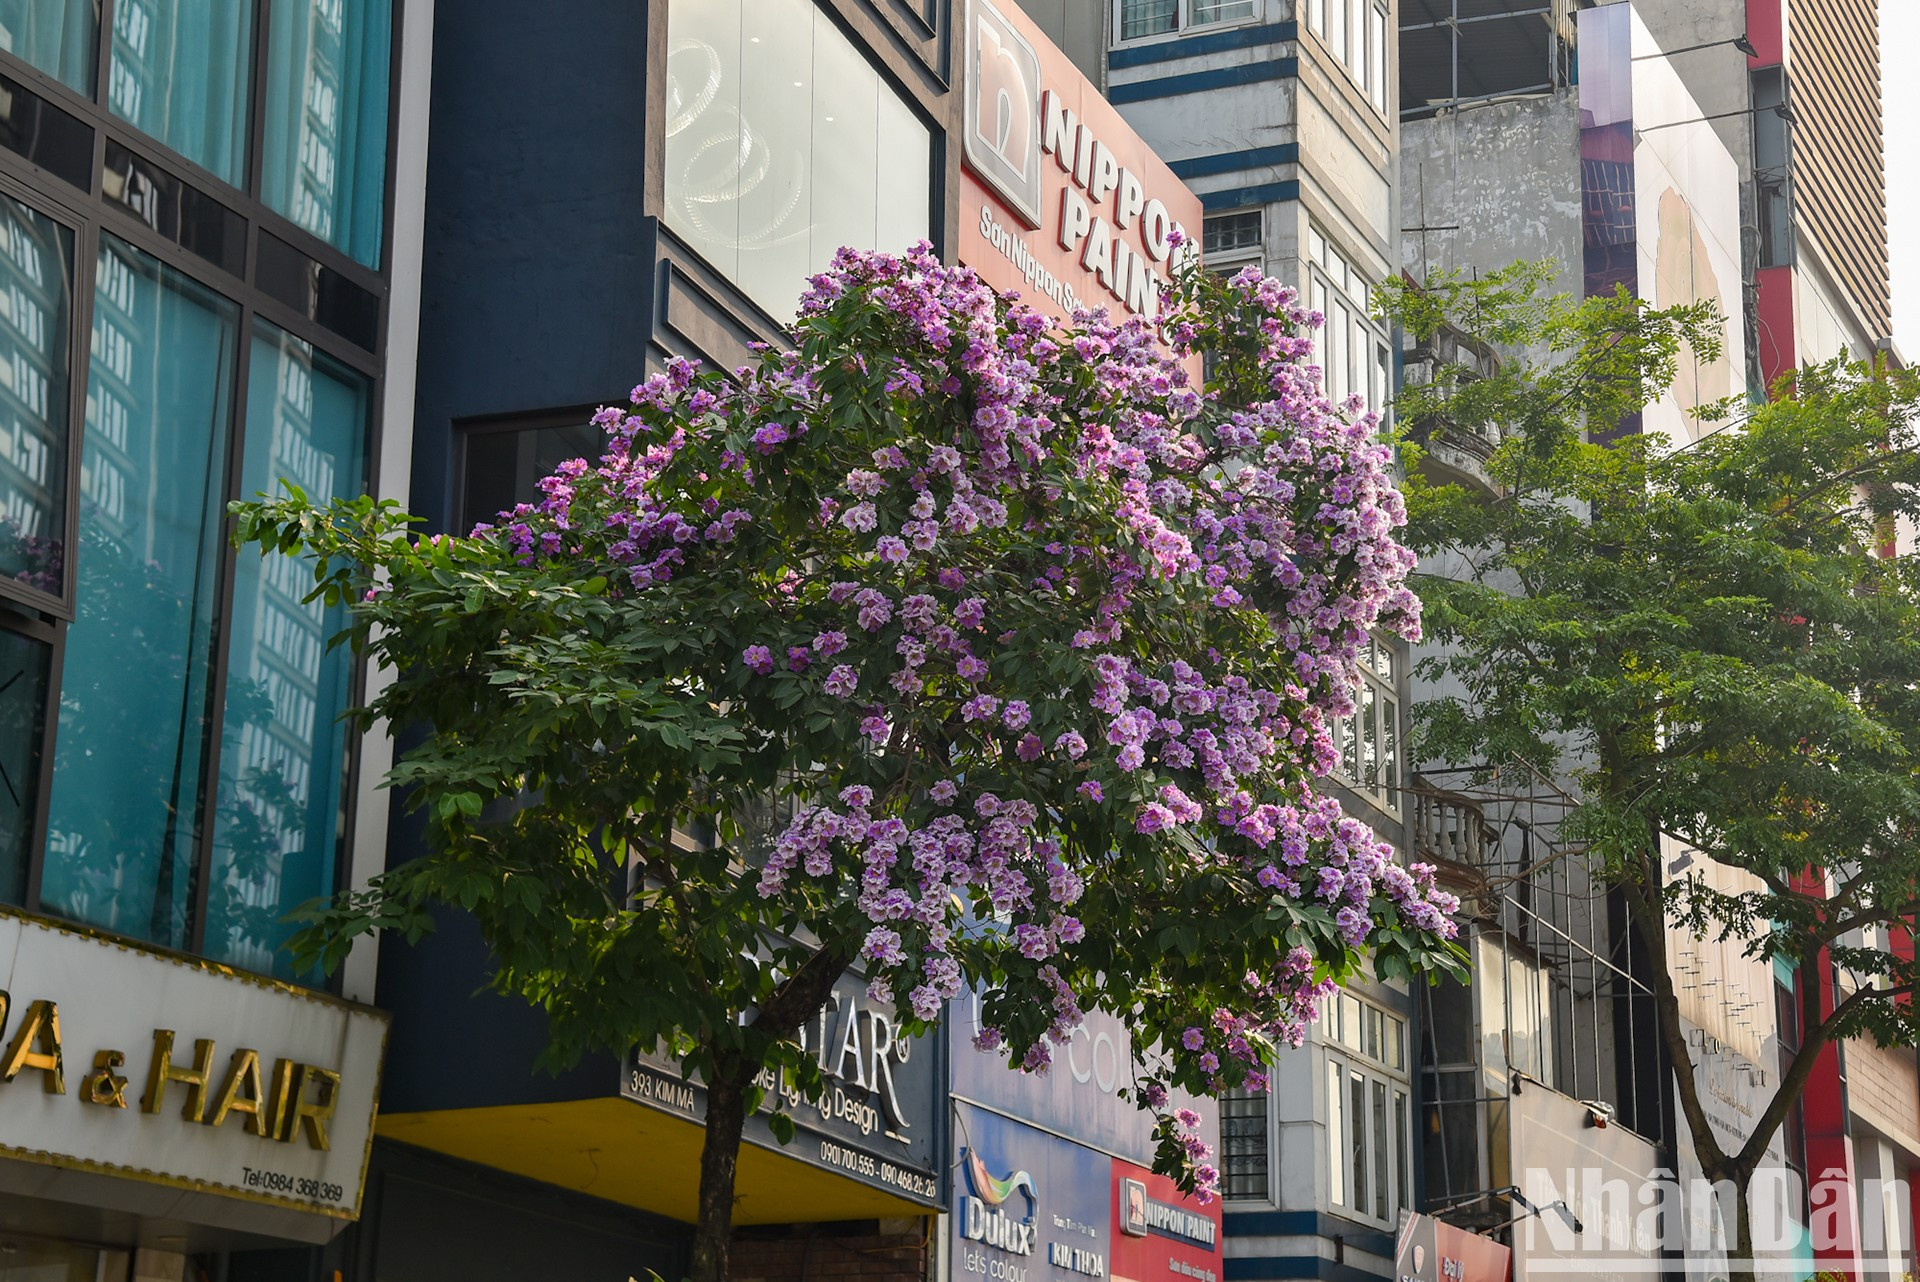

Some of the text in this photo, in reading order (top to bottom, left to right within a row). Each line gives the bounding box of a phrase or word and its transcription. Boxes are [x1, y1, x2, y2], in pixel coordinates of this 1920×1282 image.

[1011, 232, 1062, 307] Nippon
[80, 1050, 129, 1110] &
[141, 1029, 341, 1152] HAIR
[631, 1070, 652, 1096] 393
[655, 1078, 675, 1104] KIM
[834, 1088, 879, 1135] Design
[296, 1177, 319, 1198] 368
[319, 1182, 343, 1202] 369
[963, 1195, 1031, 1256] Dulux
[1146, 1202, 1216, 1245] NIPPON PAINT
[1074, 1248, 1104, 1278] THOA
